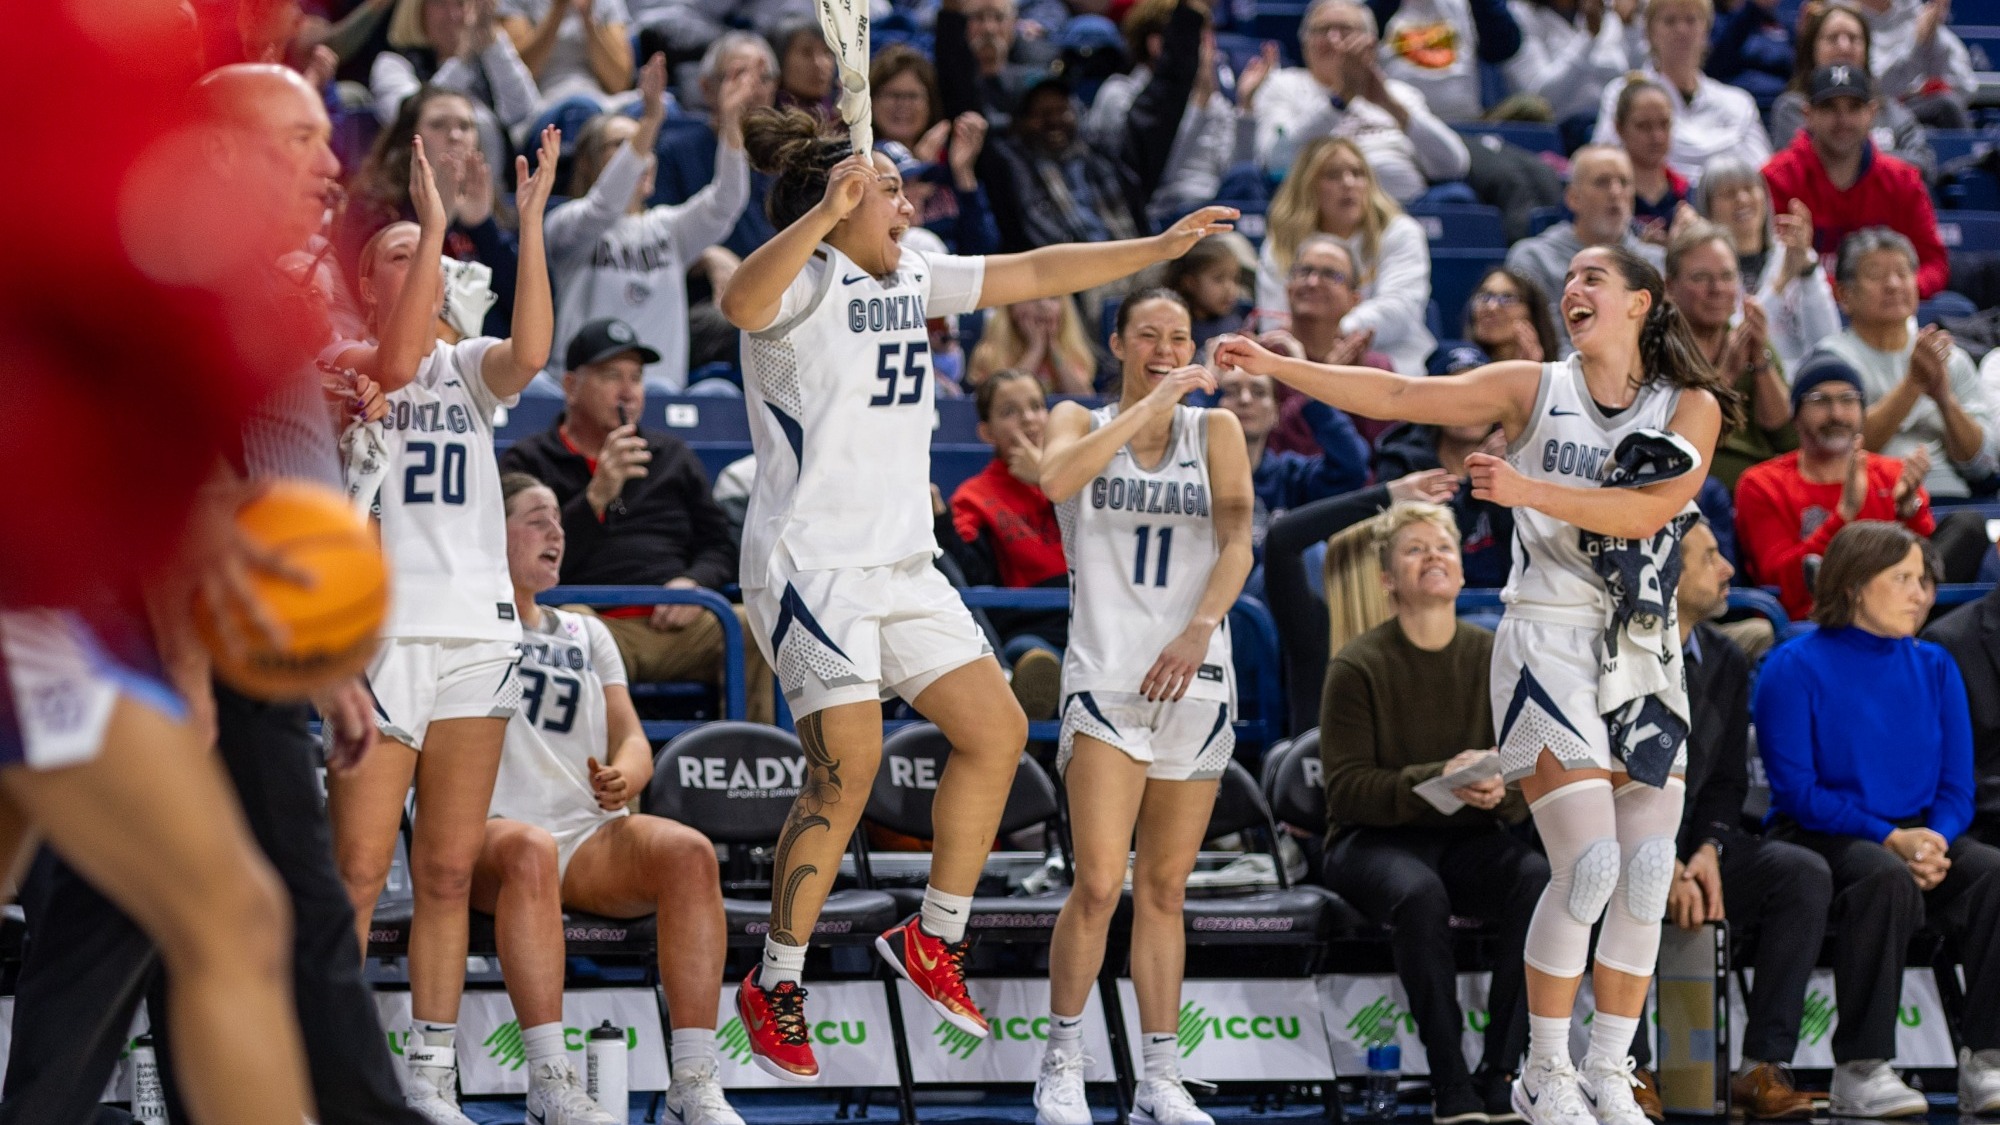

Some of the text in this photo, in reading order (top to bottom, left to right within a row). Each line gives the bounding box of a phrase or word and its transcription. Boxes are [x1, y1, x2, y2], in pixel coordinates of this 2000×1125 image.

[848, 294, 927, 333] GONZA
[869, 342, 928, 406] 55
[404, 441, 466, 505] 20
[1092, 477, 1208, 517] GONZAGA
[1134, 524, 1173, 587] 11
[519, 667, 581, 734] 33
[678, 755, 807, 789] READY
[726, 788, 769, 799] SPORTS
[969, 914, 1059, 928] GOZAGS.CO
[1192, 916, 1294, 932] GOZAGS.COM
[992, 1016, 1051, 1041] ICC
[1212, 1016, 1300, 1039] ICCU
